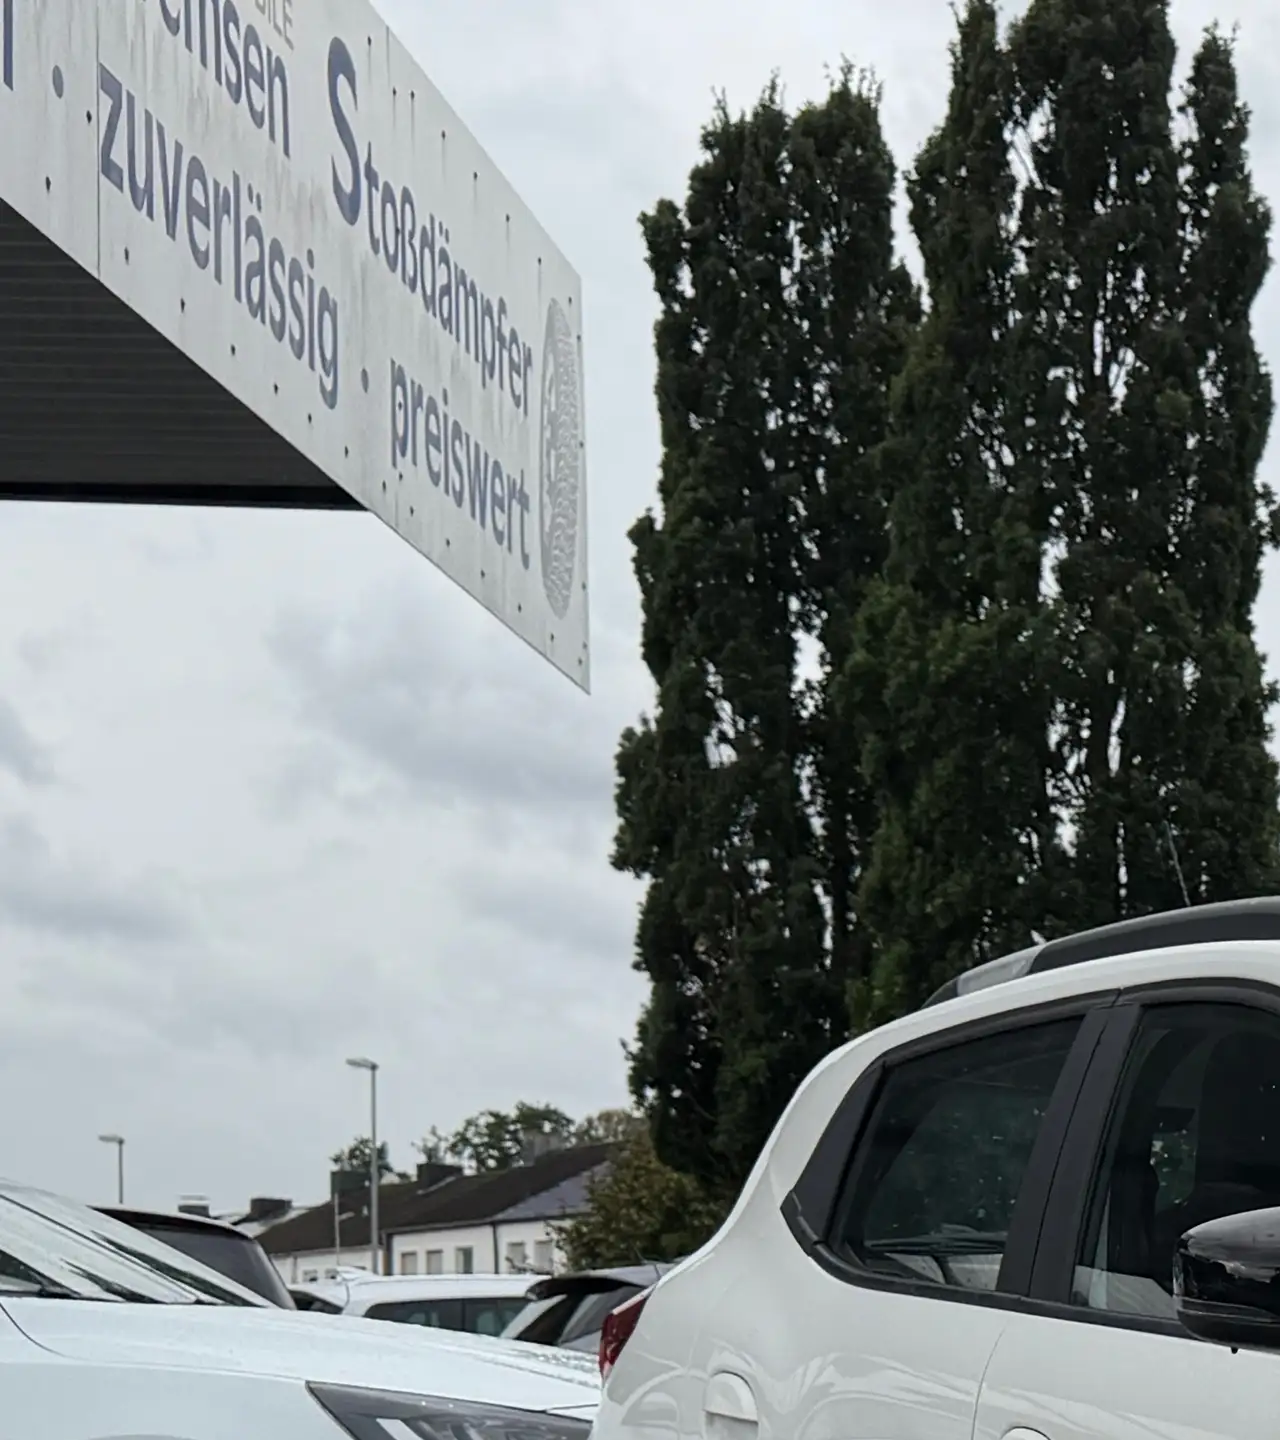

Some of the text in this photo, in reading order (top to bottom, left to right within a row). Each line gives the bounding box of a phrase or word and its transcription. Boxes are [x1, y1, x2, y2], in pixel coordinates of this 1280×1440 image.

[99, 61, 338, 410] zuverlässig
[390, 357, 531, 570] preiswert
[327, 36, 533, 417] Stoßdämpfer
